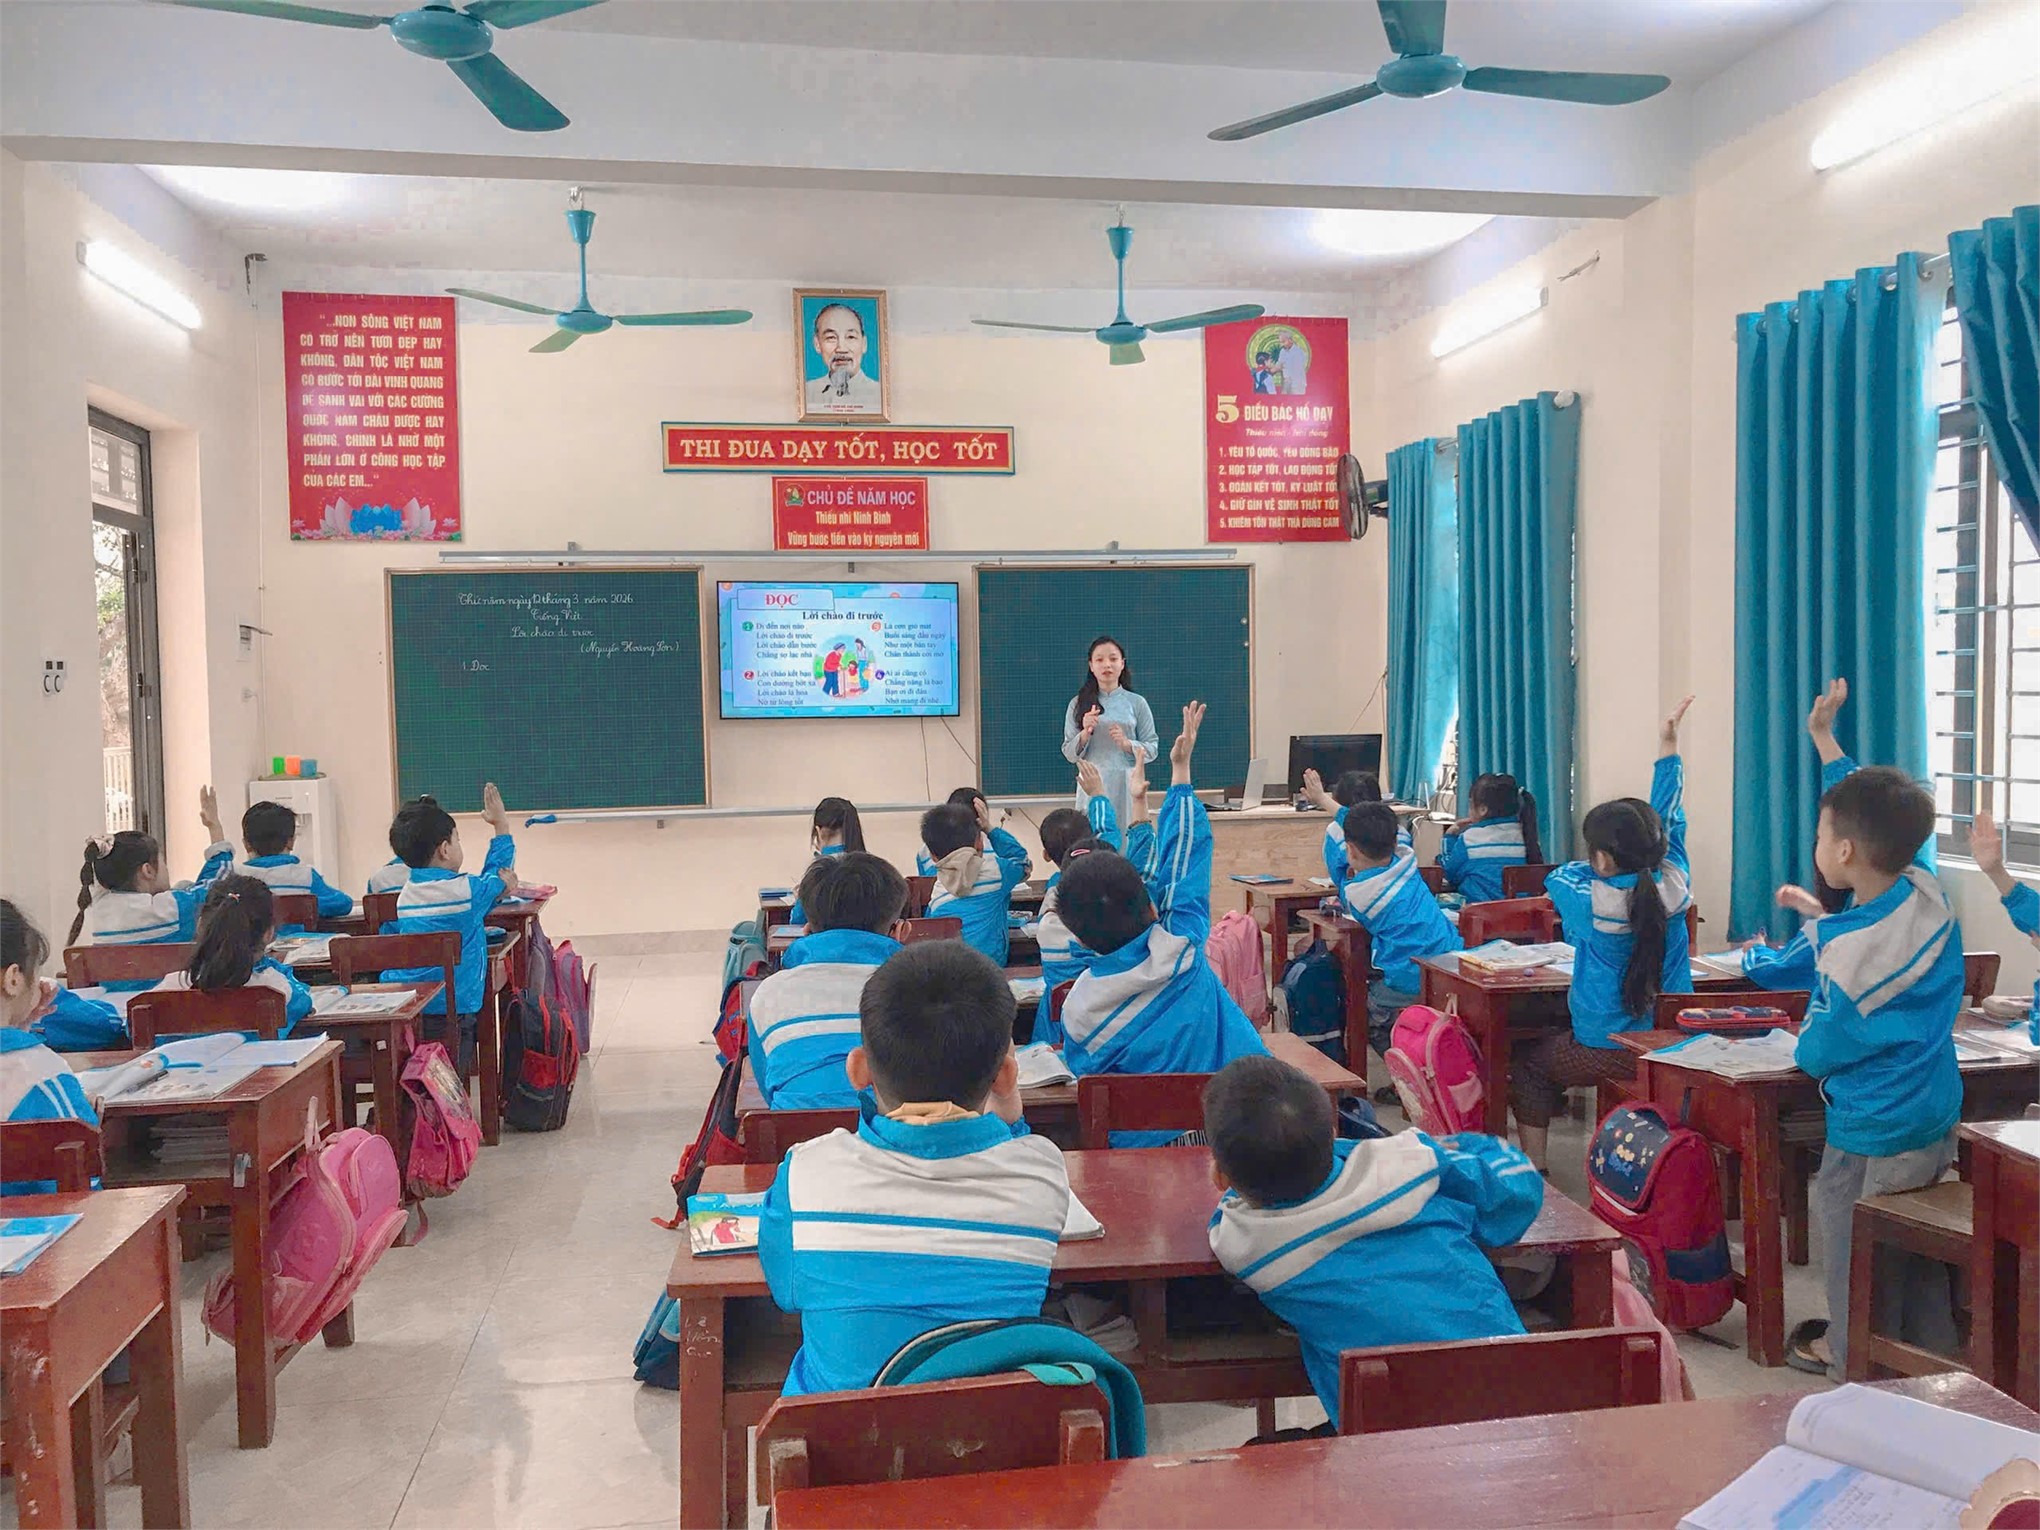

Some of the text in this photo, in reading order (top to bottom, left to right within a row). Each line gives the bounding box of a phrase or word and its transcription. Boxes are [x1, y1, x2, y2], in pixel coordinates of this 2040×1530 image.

[362, 314, 389, 329] SÔNG
[394, 314, 414, 332] VIỆT
[419, 317, 442, 330] NAM
[344, 333, 365, 348] NÊN
[398, 337, 417, 351] ĐẸP
[424, 338, 442, 350] HAY
[370, 353, 389, 370] TỘC
[394, 354, 414, 371] VIỆT
[420, 356, 443, 369] NAM
[347, 372, 362, 387] TỚI
[384, 376, 407, 389] VINH
[410, 376, 444, 390] QUANG
[349, 395, 364, 407] VAI
[368, 392, 384, 407] VỚI
[411, 393, 444, 409] CƯỜNG
[1216, 394, 1240, 423] 5
[1244, 401, 1269, 421] ĐIỀU
[1272, 403, 1293, 421] BÁC
[1313, 406, 1333, 424] DẠY
[363, 412, 389, 427] CHÂU
[394, 416, 420, 431] ĐƯỢC
[426, 416, 444, 428] HAY
[382, 432, 393, 447] LÀ
[398, 432, 419, 447] NHỜ
[424, 434, 445, 450] MỘT
[680, 432, 998, 465] THI ĐUA DẠY TỐT, HỌC TỐT
[336, 450, 355, 466] LỚN
[371, 452, 399, 466] CÔNG
[402, 454, 423, 470] HỌC
[427, 453, 445, 470] TẬP
[1219, 447, 1227, 458] 1.
[1228, 446, 1243, 458] YÊU
[304, 469, 323, 486] CỦA
[327, 472, 346, 487] CÁC
[1219, 465, 1227, 475] 2.
[1228, 465, 1245, 477] HỌC
[1284, 465, 1299, 475] LAO
[1219, 482, 1227, 492] 3.
[808, 484, 916, 510] CHỦ ĐỀ NĂM HỌC
[1219, 500, 1228, 510] 4.
[1278, 500, 1298, 510] SINH
[1325, 498, 1339, 510] TỐT
[816, 510, 891, 525] Thiếu nhi Ninh Bình
[1220, 518, 1227, 528] 5.
[788, 531, 807, 547] Vững
[831, 531, 846, 545] tiến
[848, 533, 861, 545] vào
[875, 533, 902, 547] nguyên
[905, 532, 920, 545] mới
[458, 592, 481, 605] Thứ
[483, 597, 506, 605] năm
[508, 595, 531, 610] ngày
[542, 592, 571, 608] tháng
[572, 593, 579, 604] 3
[584, 596, 608, 604] năm
[611, 594, 634, 604] 2026
[765, 594, 799, 608] ĐỌC
[530, 608, 560, 626] Tiếng
[802, 611, 884, 620] Lời chào đi trước
